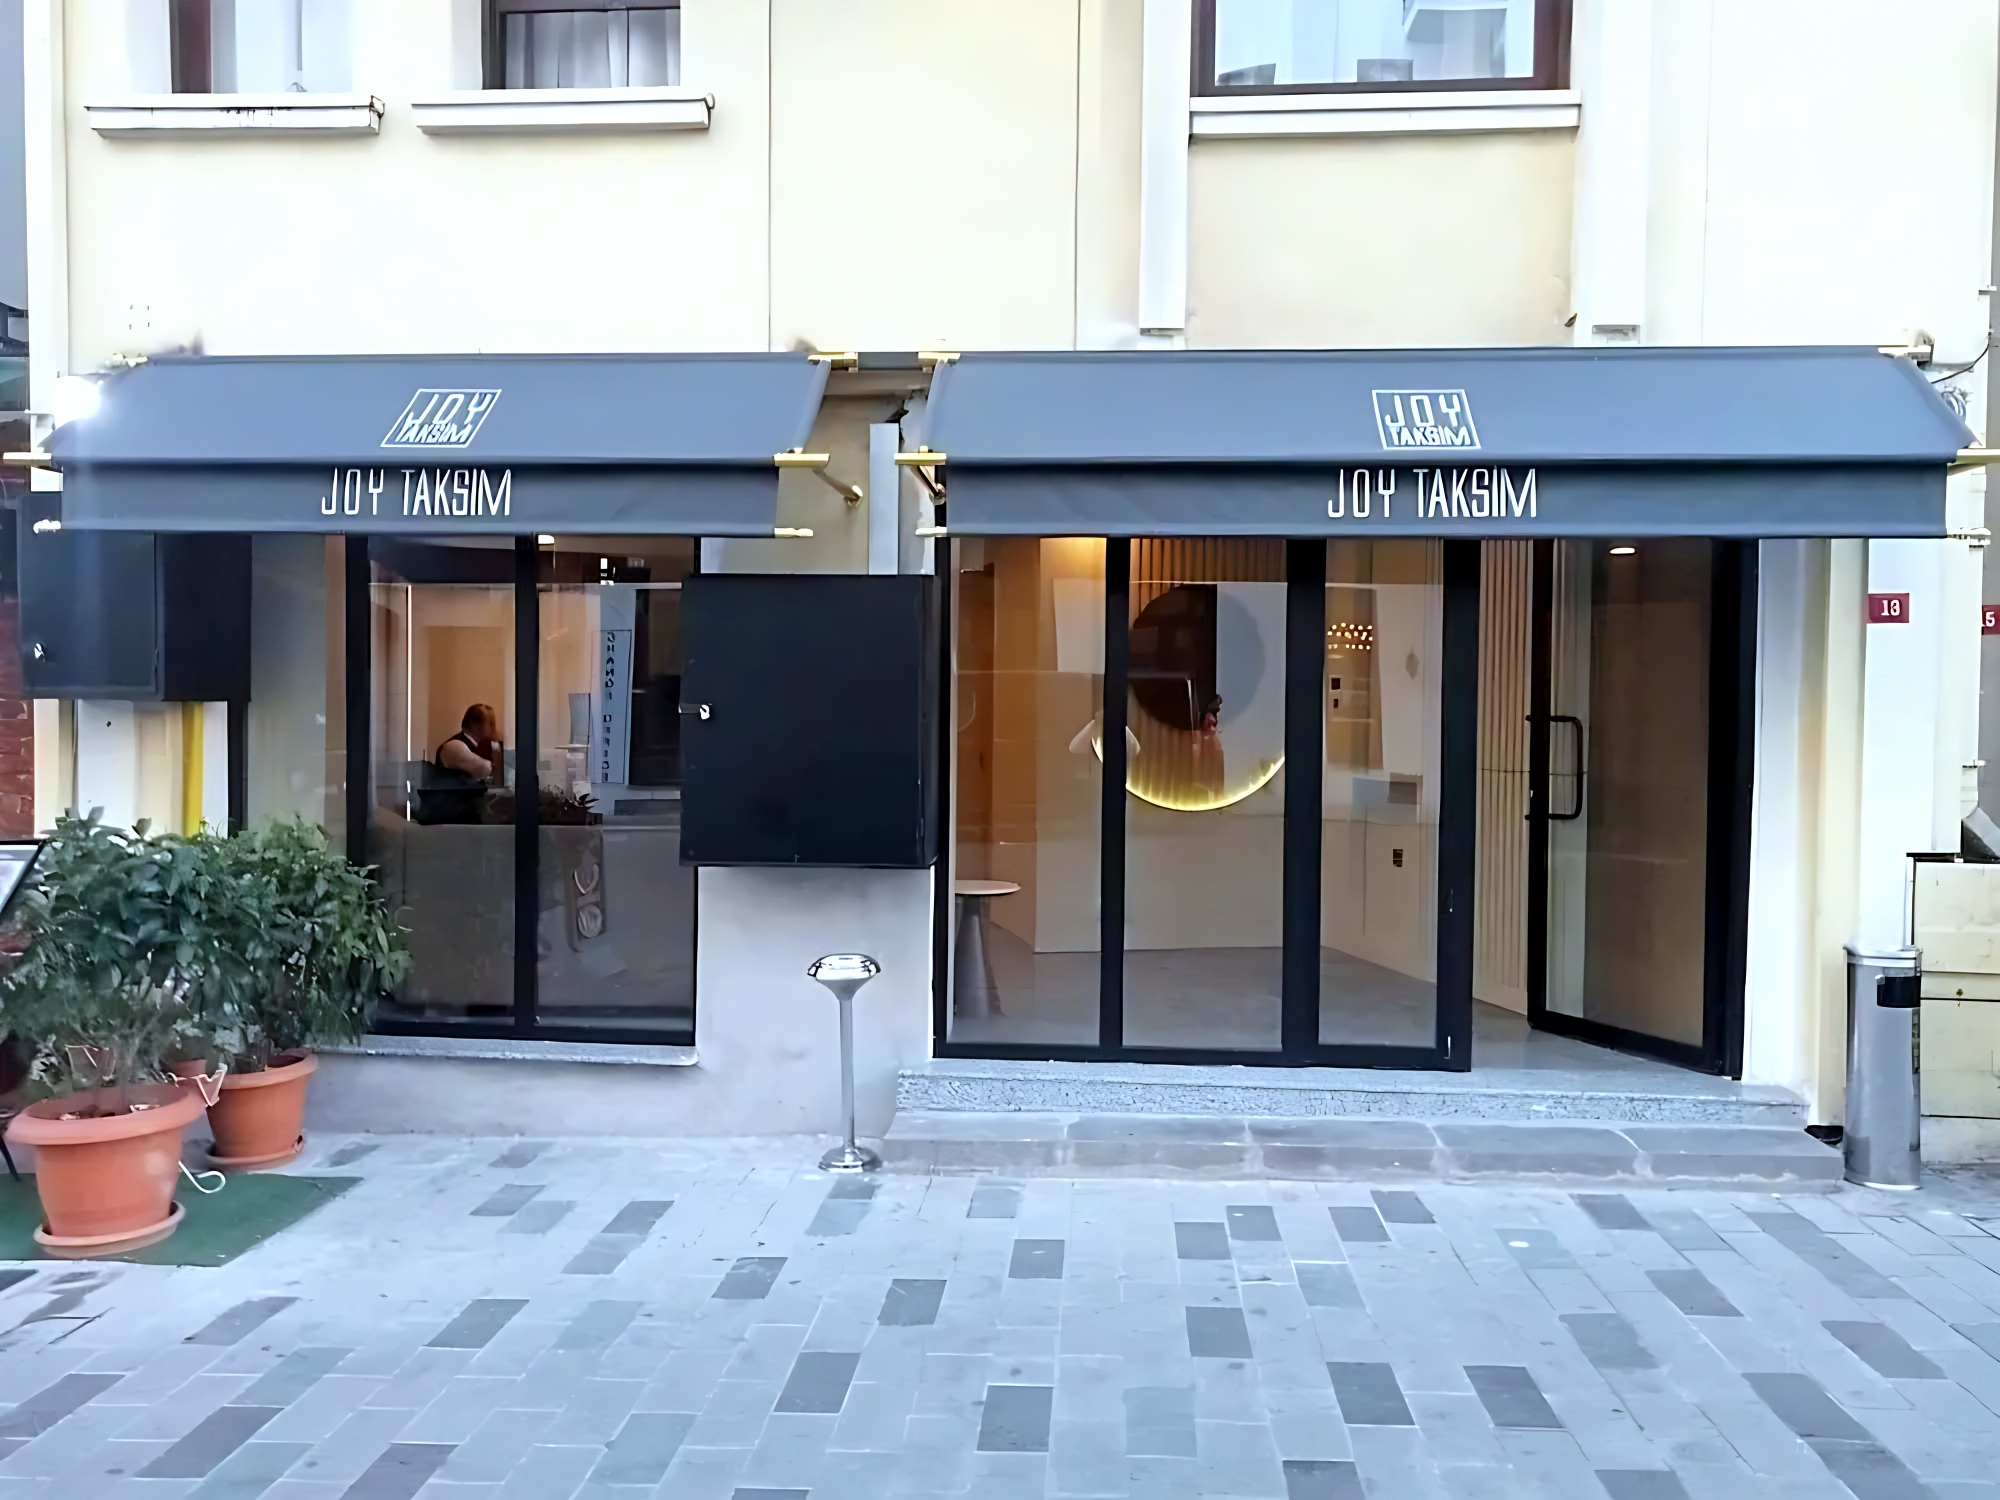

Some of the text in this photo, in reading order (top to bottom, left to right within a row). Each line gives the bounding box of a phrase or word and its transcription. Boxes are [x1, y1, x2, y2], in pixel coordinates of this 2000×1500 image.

[408, 391, 492, 425] JOY
[1384, 394, 1461, 427] JOY
[395, 421, 473, 444] TAKSIM
[1389, 425, 1471, 446] TAKSIM
[321, 467, 512, 517] JOY TAKSIM
[1327, 467, 1537, 518] JOY TAKSIM
[1983, 611, 1996, 627] 5
